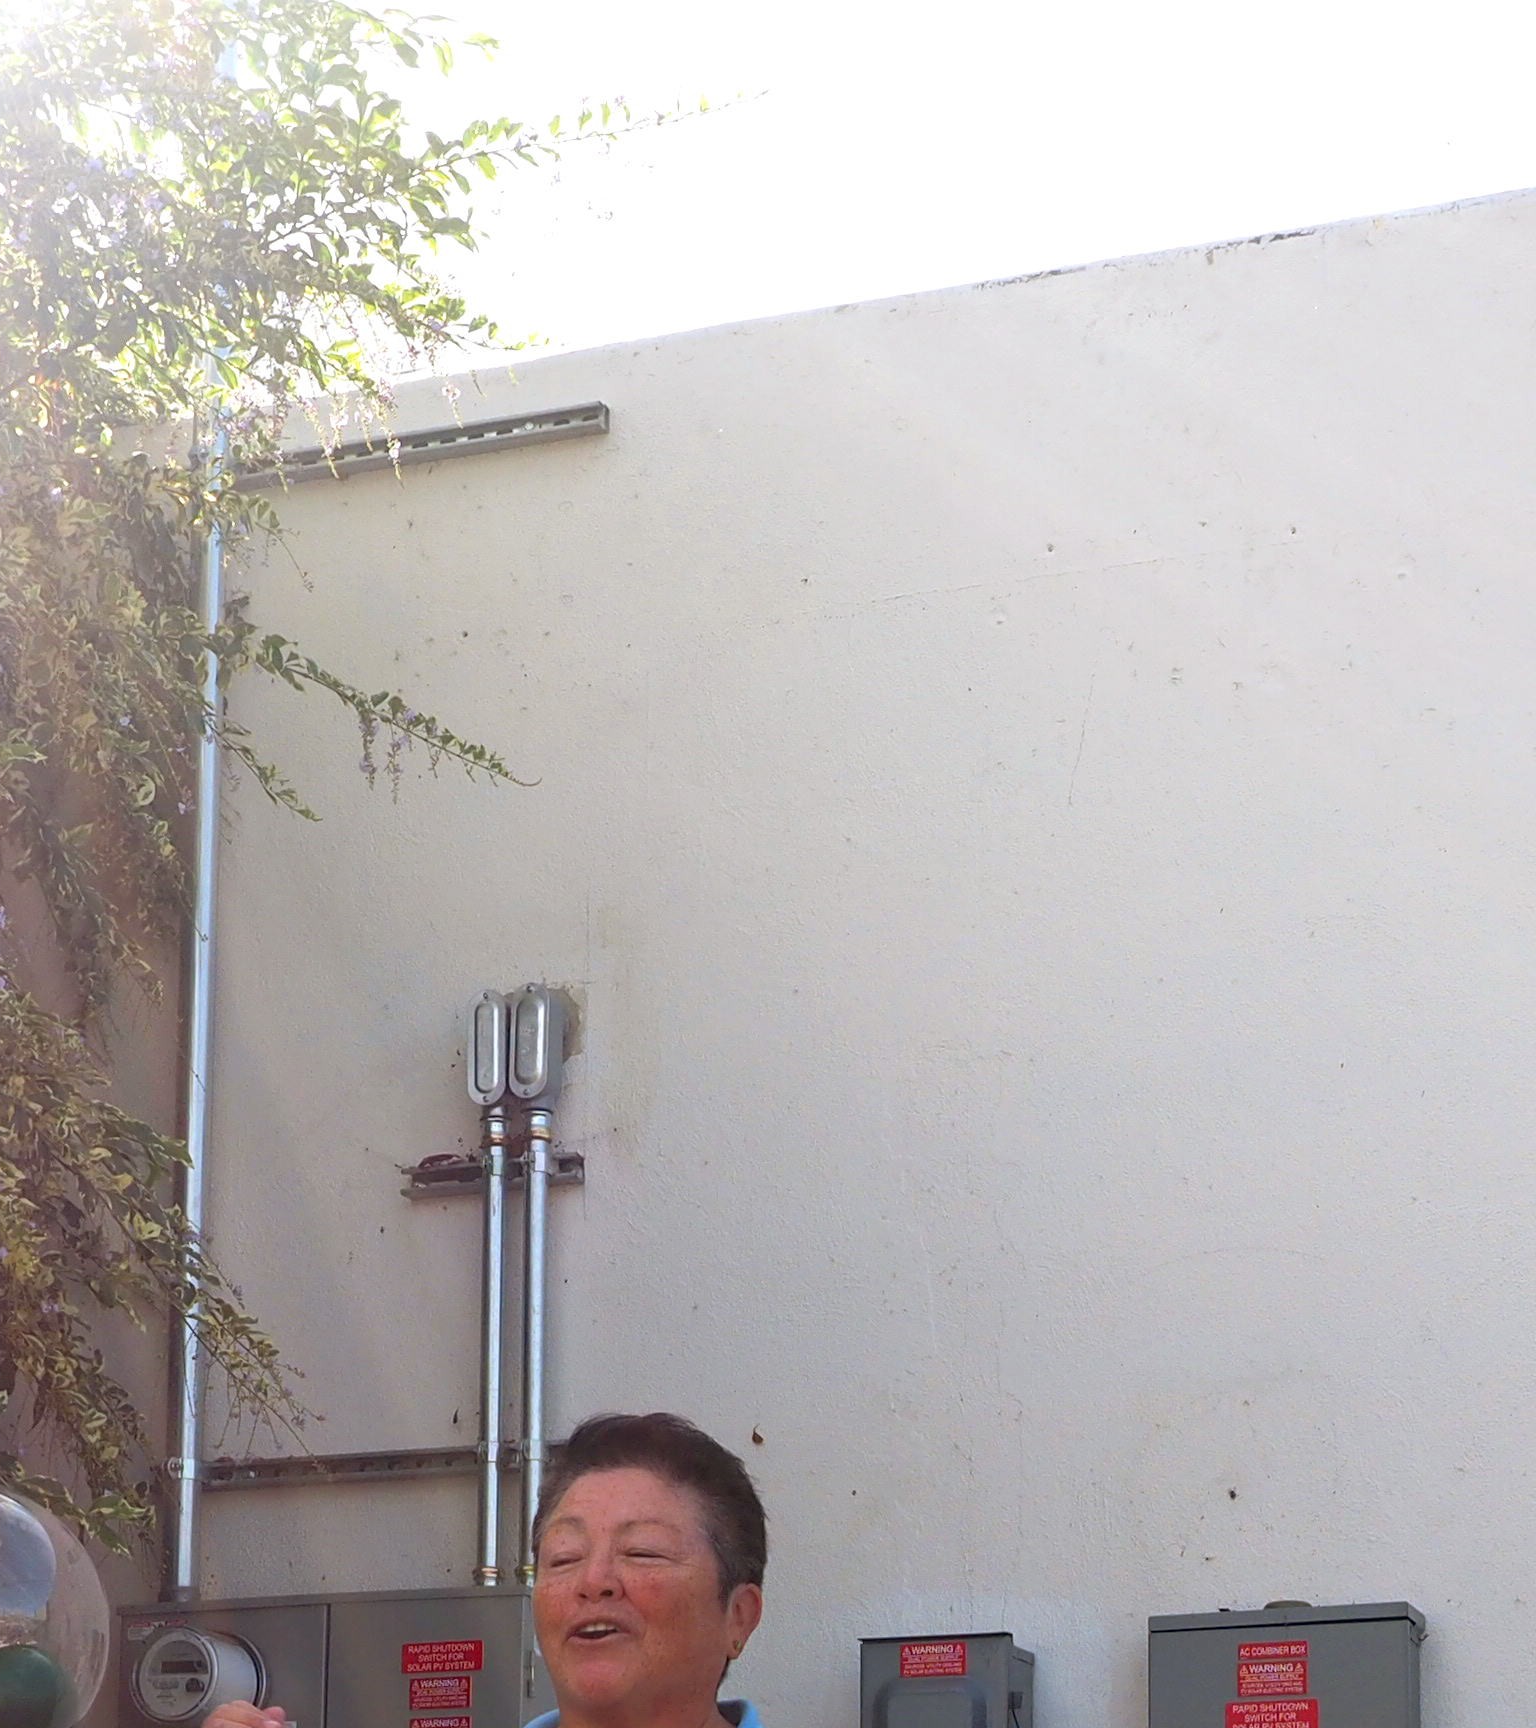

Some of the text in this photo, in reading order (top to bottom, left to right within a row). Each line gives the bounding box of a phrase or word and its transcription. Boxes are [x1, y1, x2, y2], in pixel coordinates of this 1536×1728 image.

[911, 1645, 953, 1654] WARNING
[1251, 1646, 1289, 1656] COMBINER
[1290, 1645, 1306, 1653] BOX
[448, 1652, 464, 1660] FOR
[445, 1661, 474, 1670] SYSTEM
[1249, 1663, 1293, 1673] WARNING
[420, 1679, 459, 1688] WARNING
[1232, 1702, 1308, 1713] RAPID SHUTDOWN
[1244, 1712, 1296, 1723] SWITCH FOR
[420, 1719, 459, 1728] WARNING
